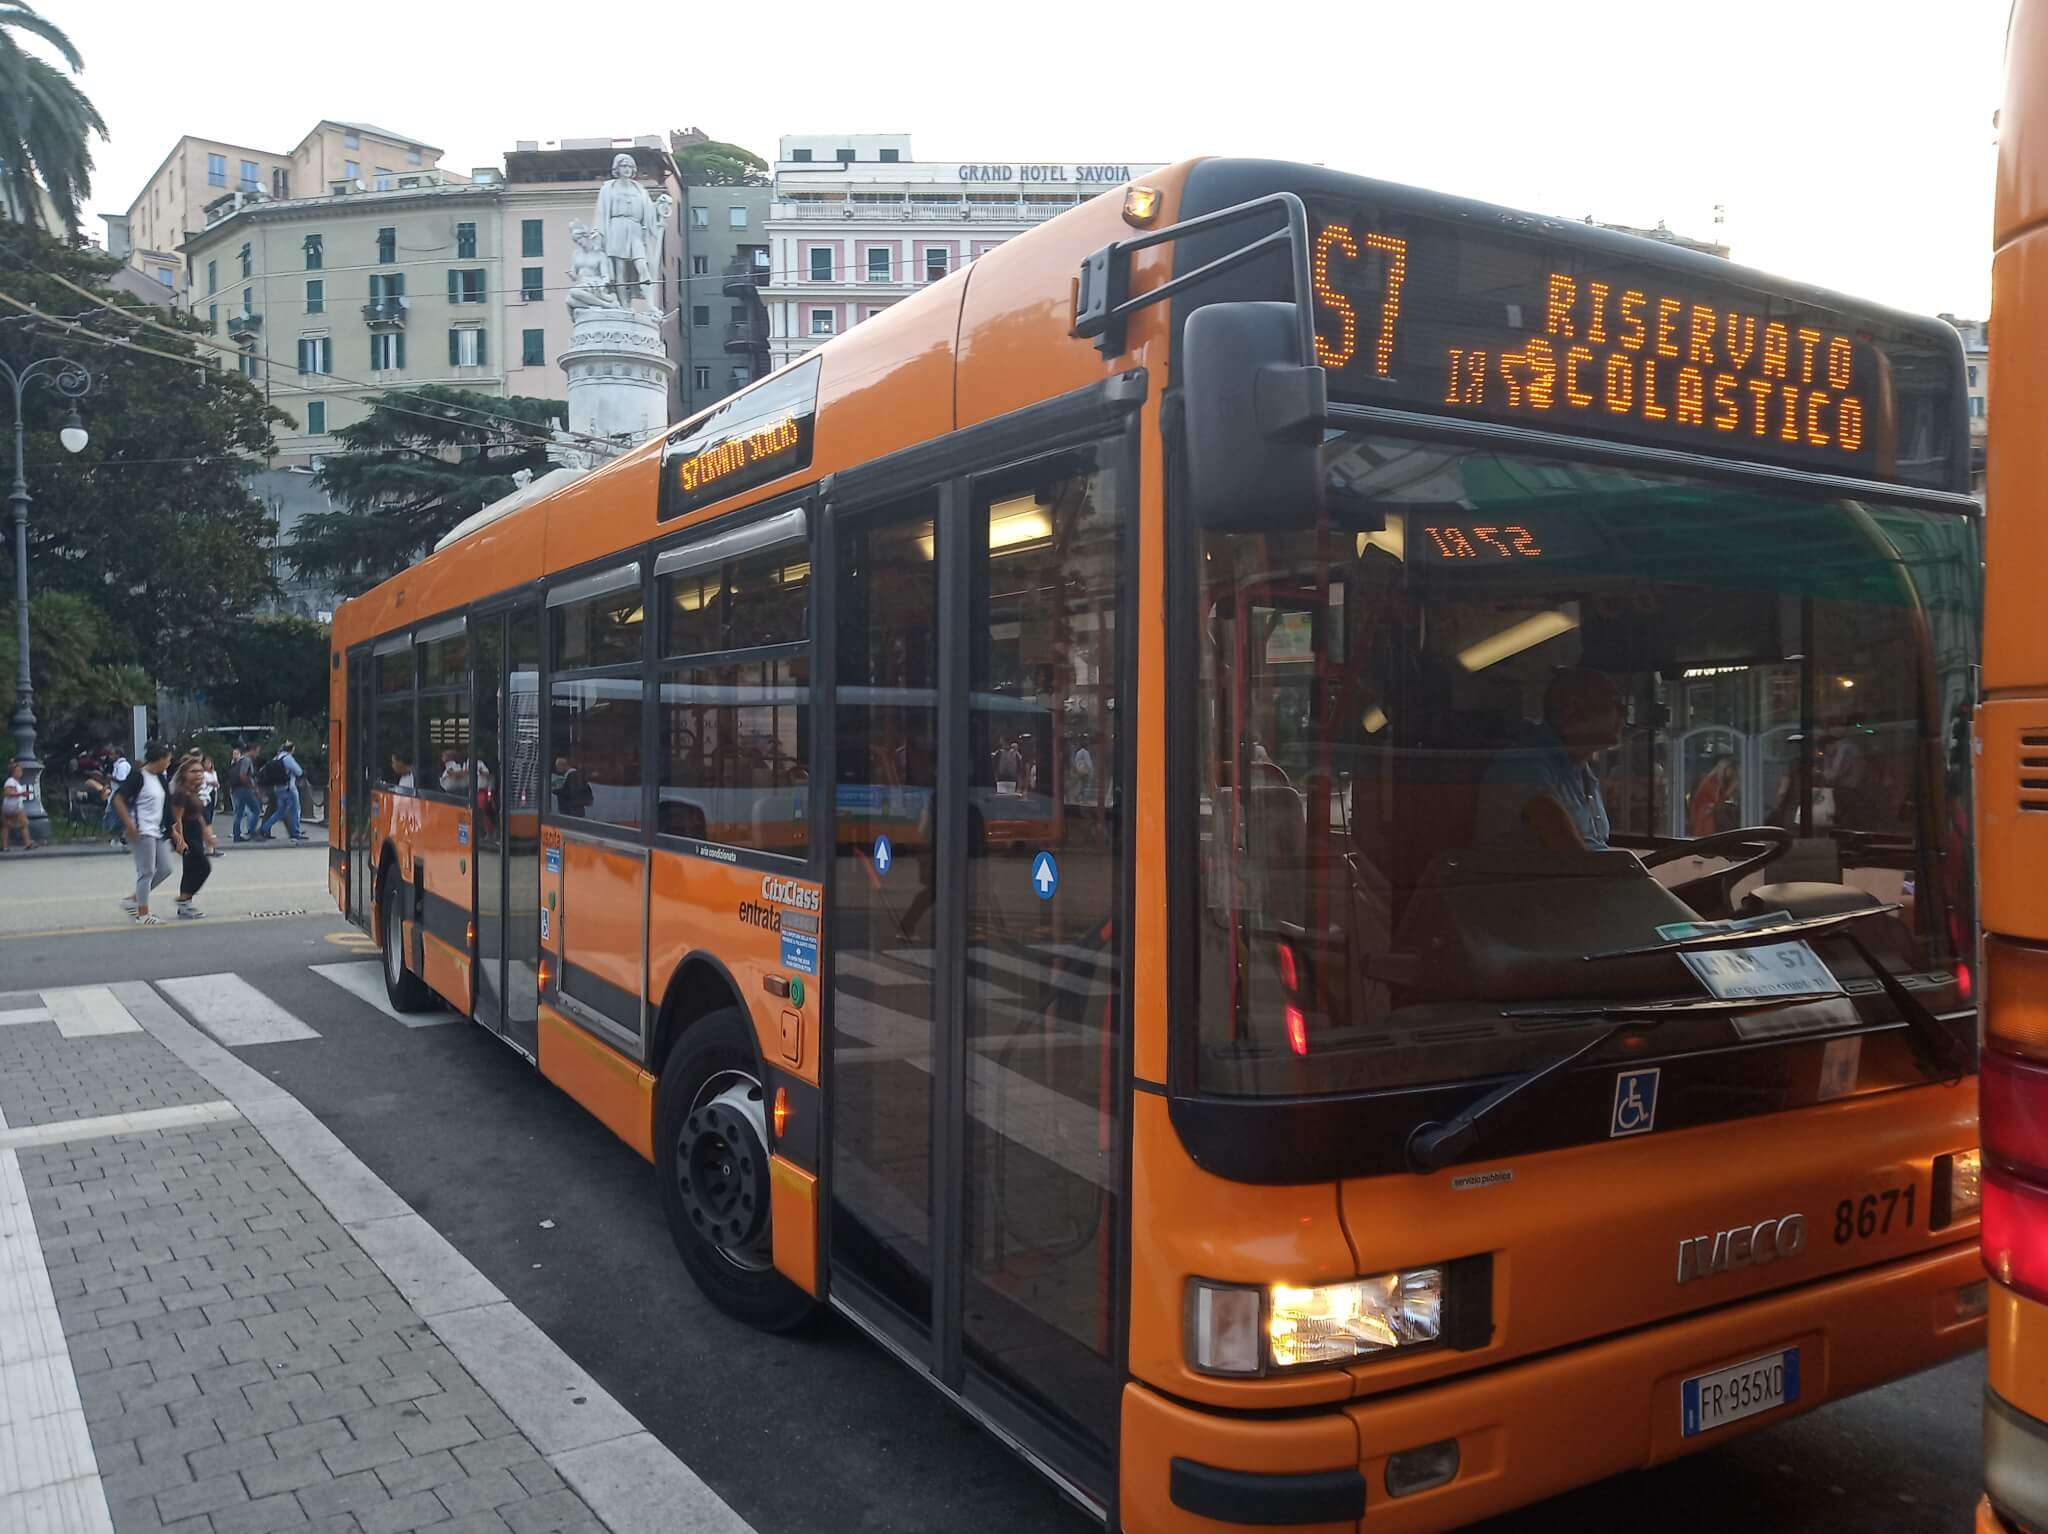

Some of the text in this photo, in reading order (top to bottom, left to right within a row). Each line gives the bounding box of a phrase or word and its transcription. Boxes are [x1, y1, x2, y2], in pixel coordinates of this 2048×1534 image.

[959, 164, 1132, 184] GRAND HOTEL SAVOIA
[1314, 223, 1407, 375] S7
[1546, 272, 1852, 391] RISERVATO
[1525, 338, 1863, 451] SCOLASTICO
[738, 899, 781, 934] entrata
[761, 875, 820, 912] CityClass
[1776, 950, 1806, 969] S7
[1833, 1183, 1916, 1246] 8671
[1677, 1213, 1807, 1284] IVECO
